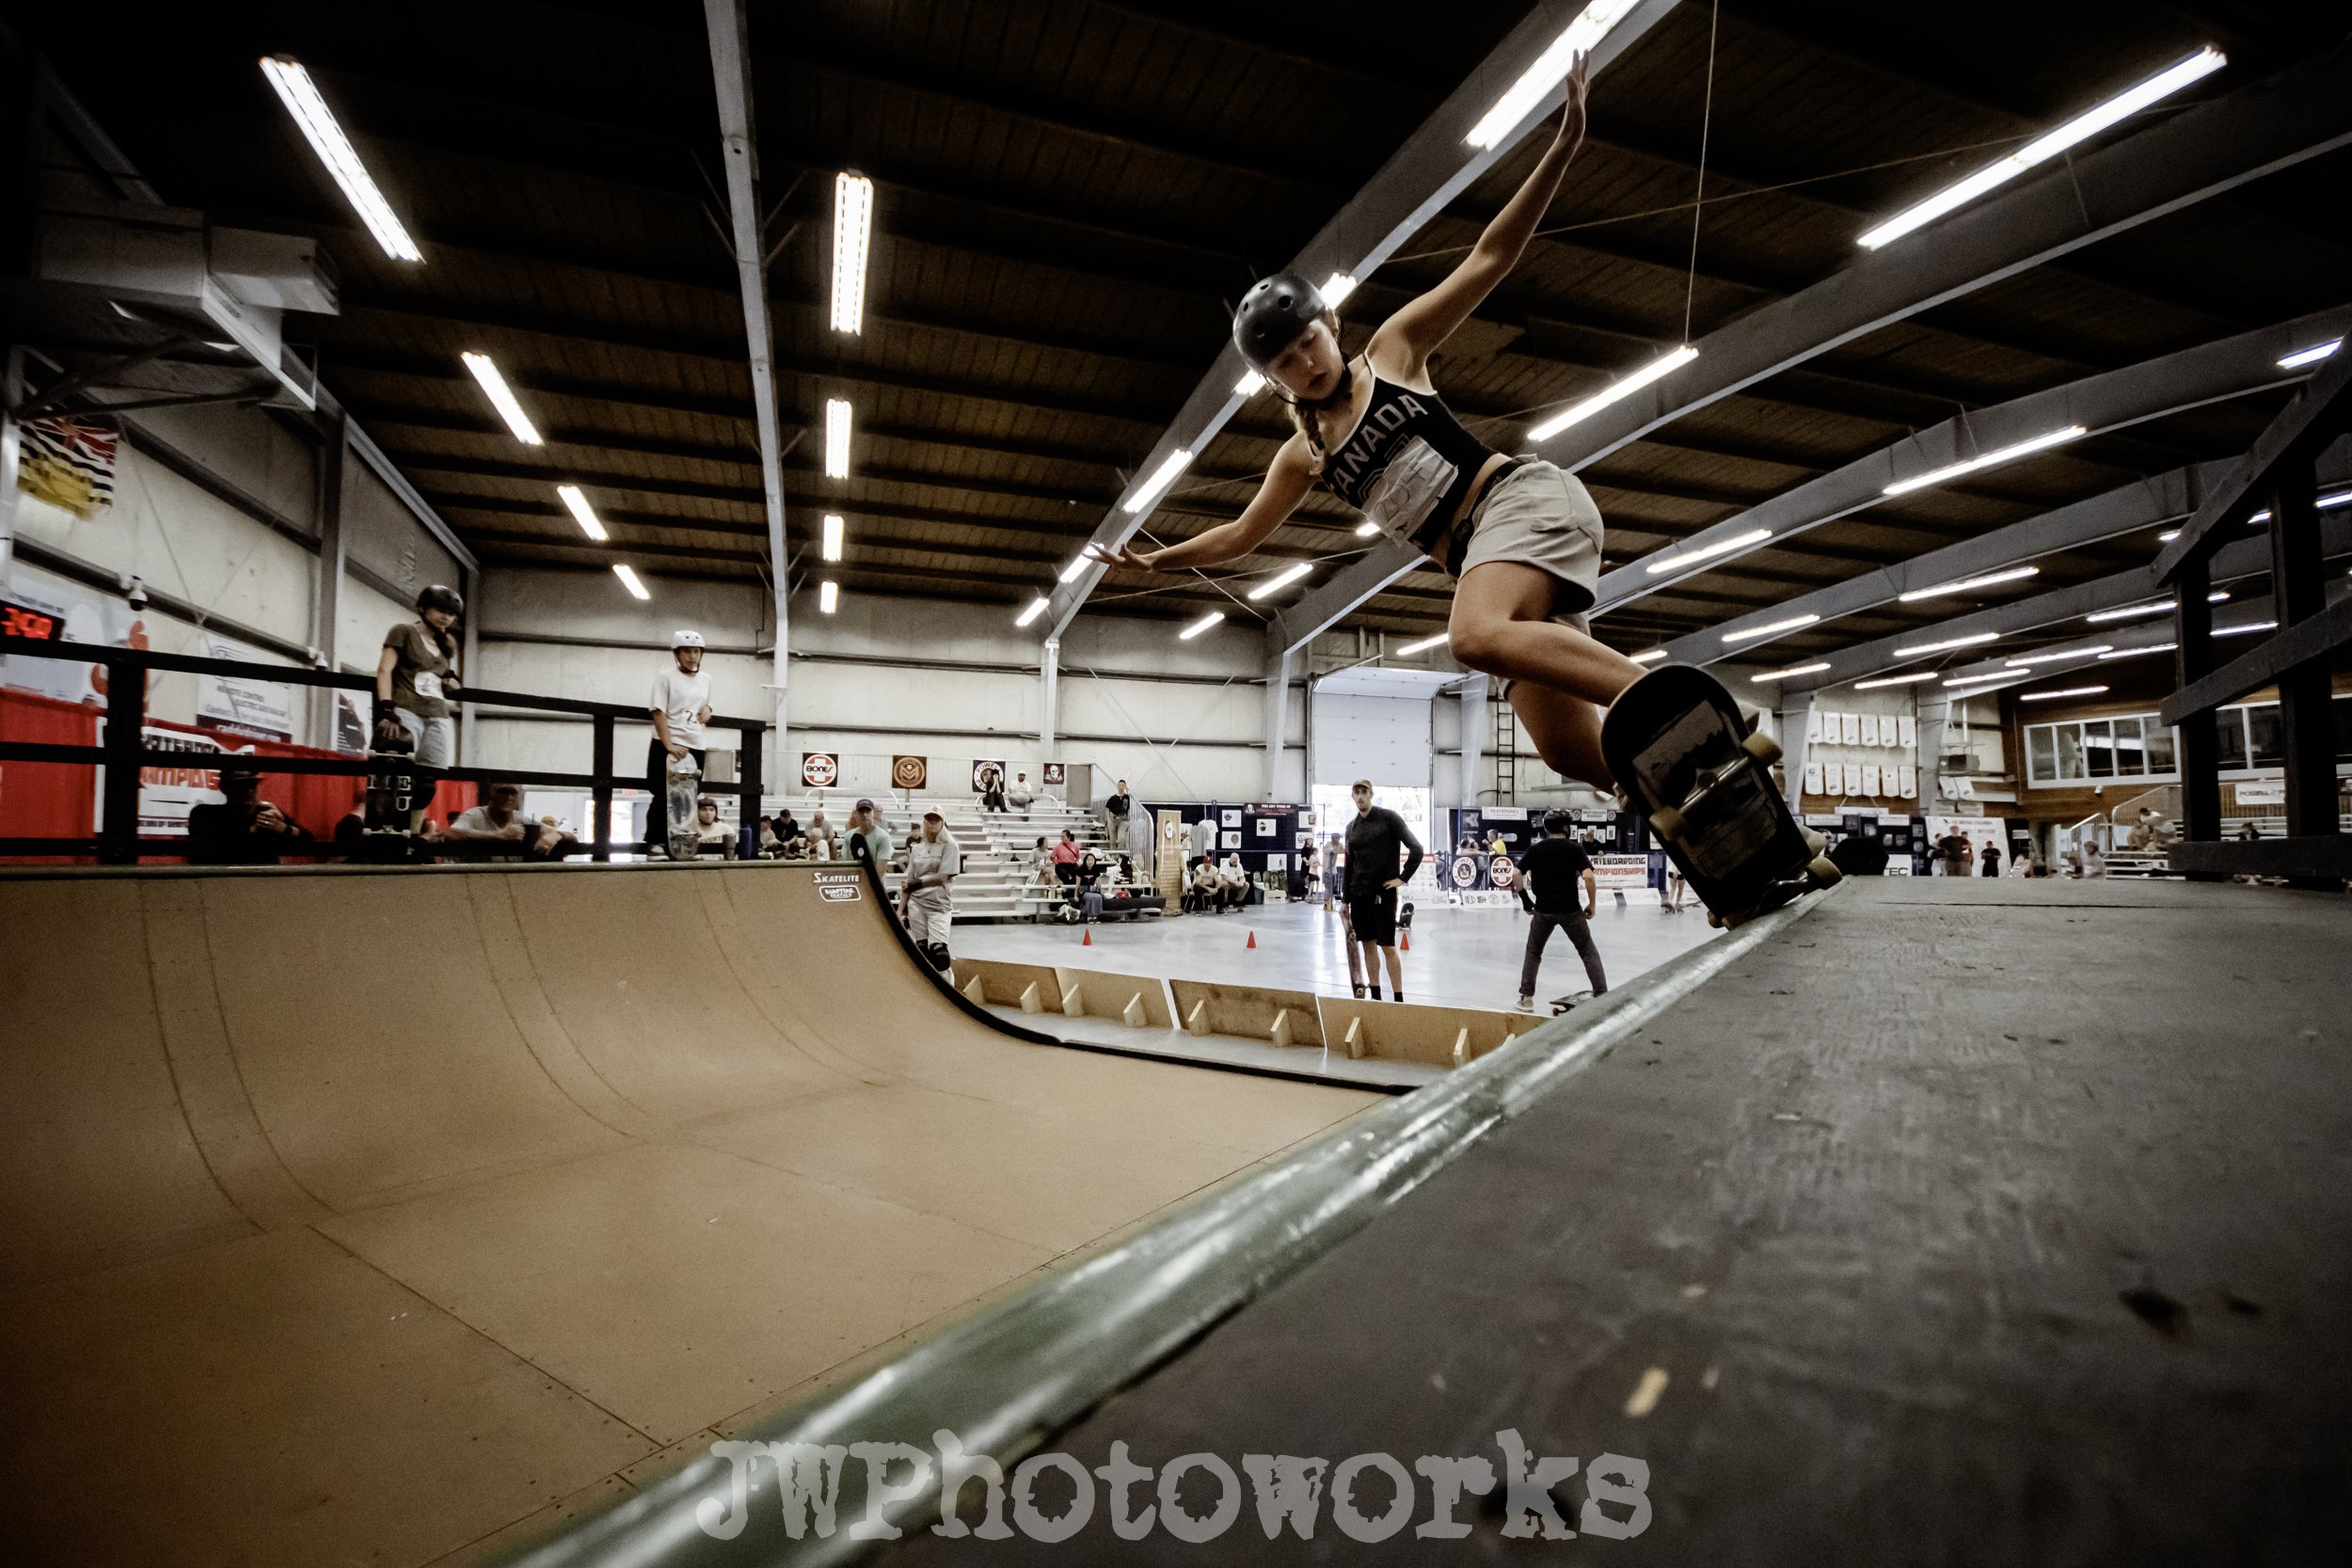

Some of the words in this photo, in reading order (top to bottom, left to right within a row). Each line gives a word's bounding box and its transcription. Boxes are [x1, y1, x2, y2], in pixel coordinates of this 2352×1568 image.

[1330, 394, 1429, 496] ANADA
[805, 765, 834, 773] BONES
[813, 872, 860, 883] SKATELITE
